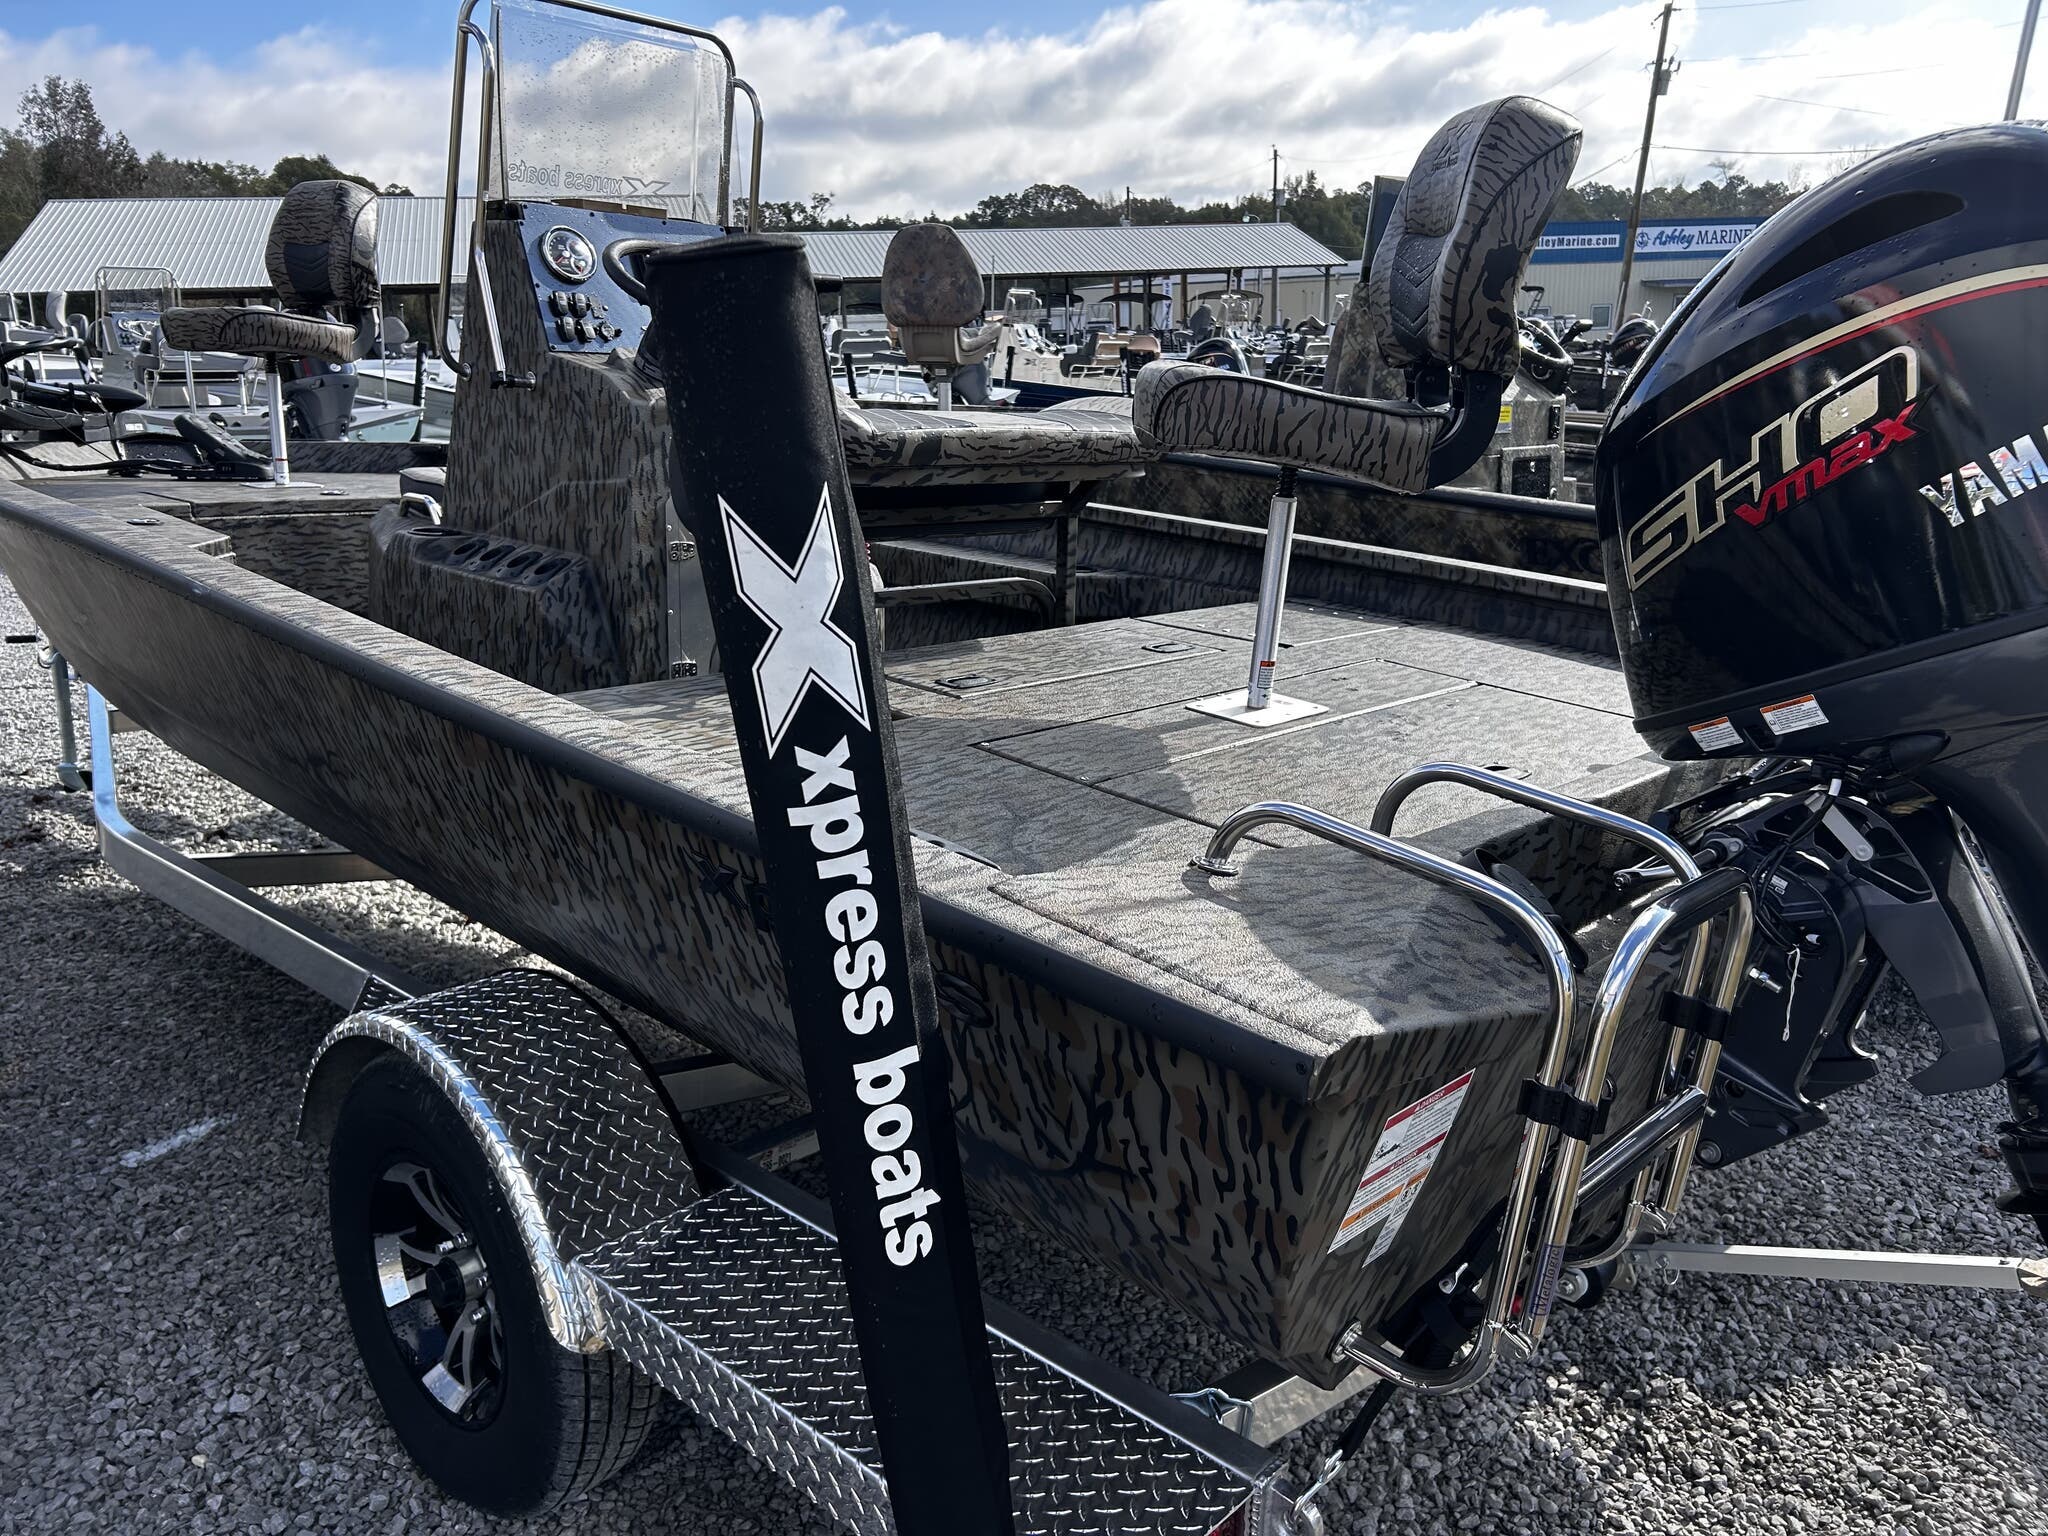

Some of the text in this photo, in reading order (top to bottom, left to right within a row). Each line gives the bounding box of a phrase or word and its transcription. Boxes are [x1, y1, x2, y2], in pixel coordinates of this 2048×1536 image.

[1652, 228, 1753, 250] Ashley MARINE
[1627, 345, 1920, 592] SHO
[1918, 424, 2048, 527] YAM
[787, 735, 895, 1035] xpress
[852, 1045, 942, 1267] boats
[1536, 1248, 1561, 1314] Metalogic
